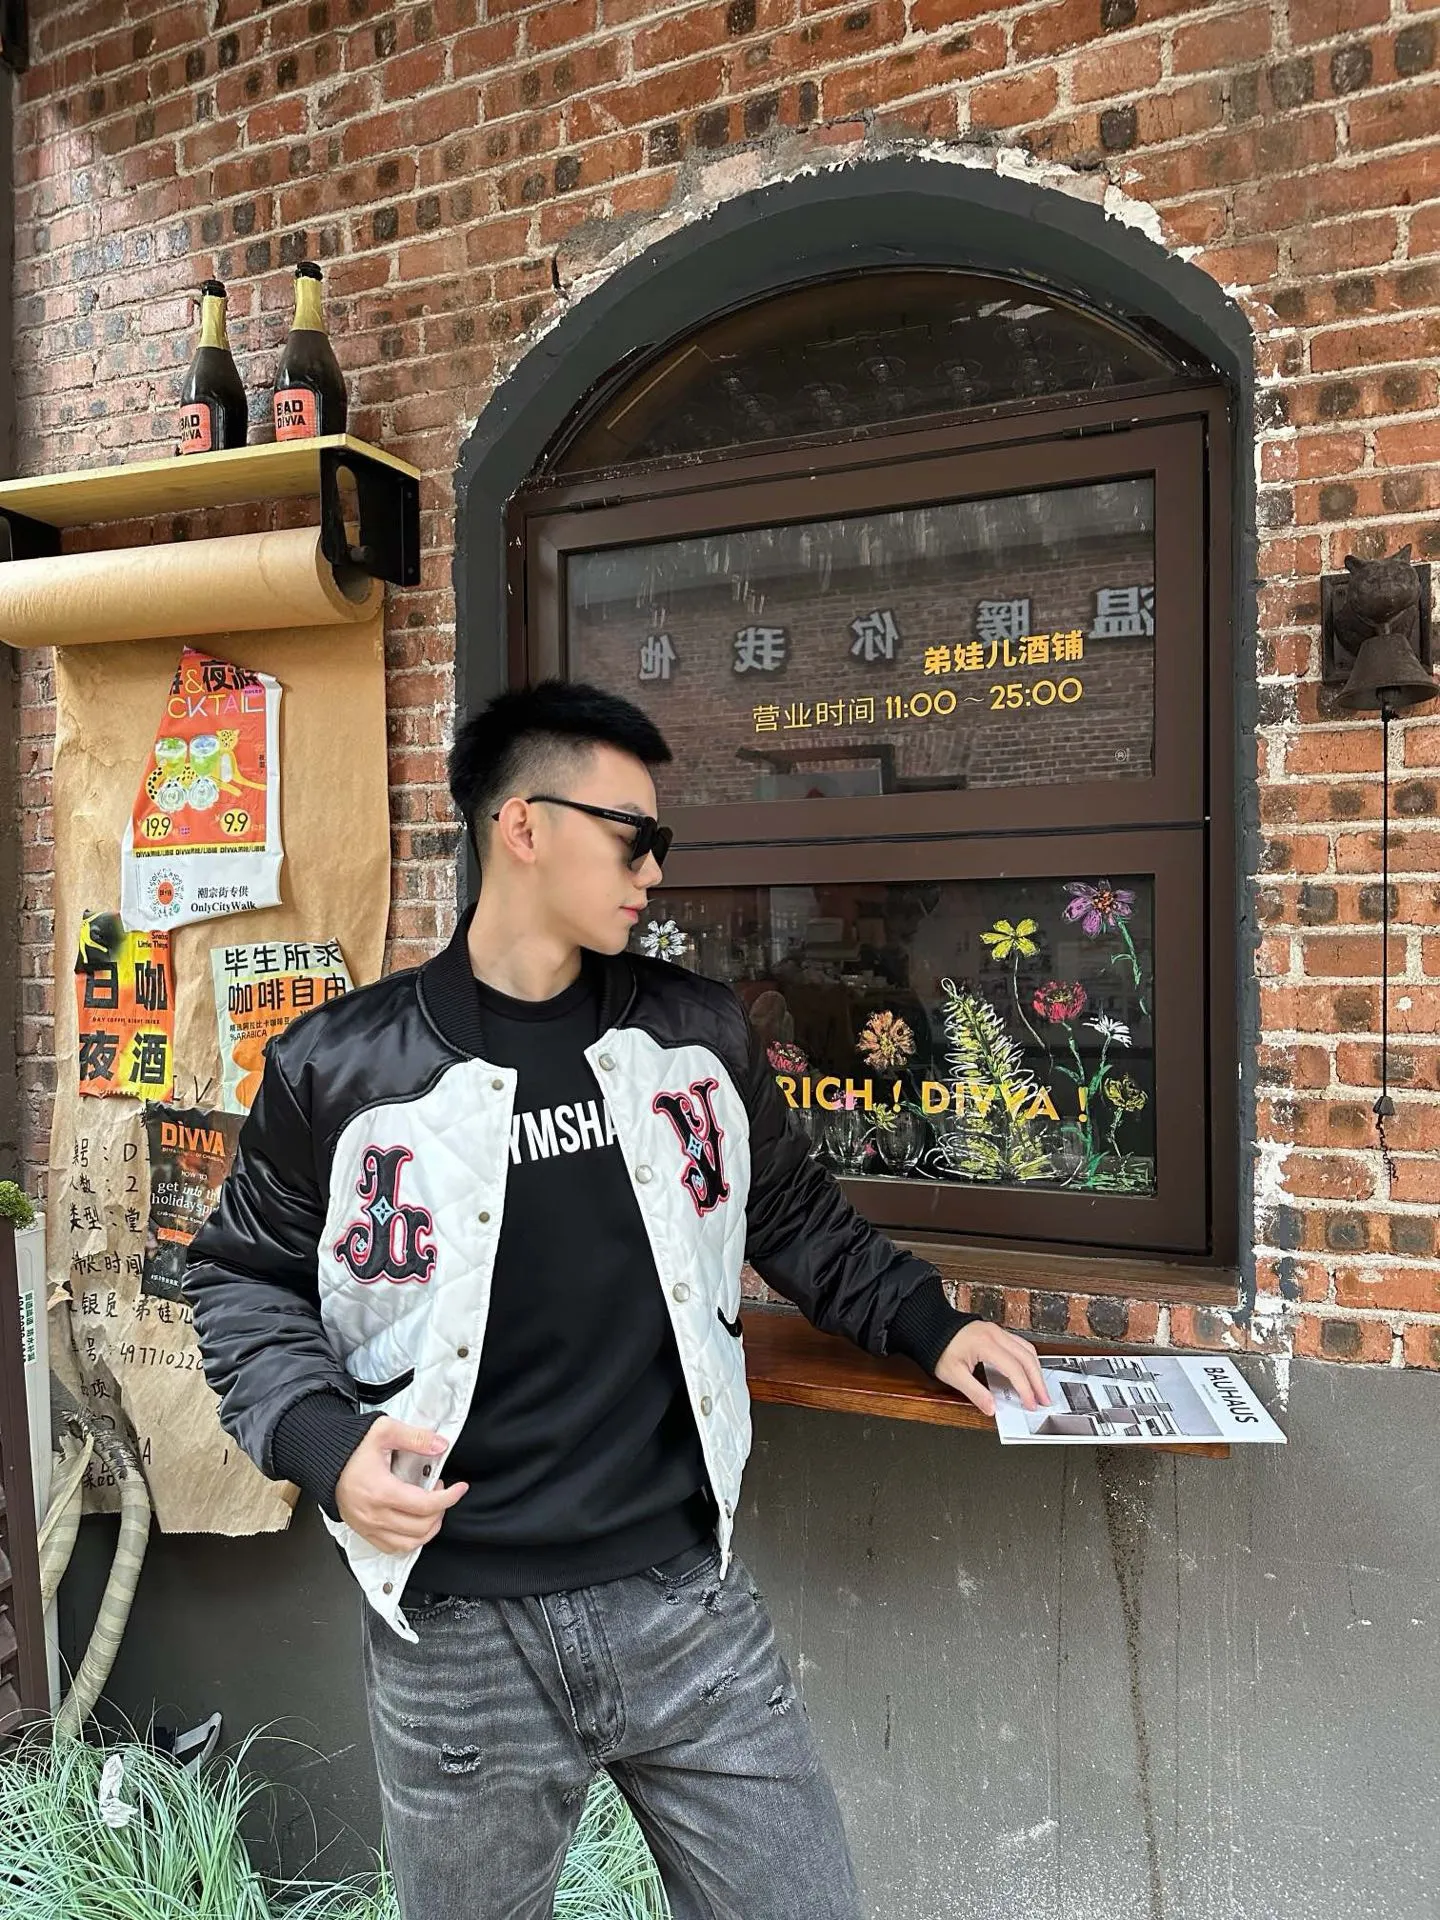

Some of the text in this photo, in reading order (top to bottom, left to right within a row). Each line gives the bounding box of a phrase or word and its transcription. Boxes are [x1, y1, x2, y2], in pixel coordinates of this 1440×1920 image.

[277, 400, 304, 416] BAD
[923, 630, 1084, 676] 弟娃儿酒铺
[752, 697, 875, 733] 营业时间
[885, 689, 957, 720] 11:00
[989, 677, 1083, 711] 25:00
[224, 813, 249, 833] 9.9
[197, 886, 249, 899] 潮宗街专供
[225, 943, 344, 977] 毕生所求
[228, 973, 347, 1015] 咖啡自由
[79, 1030, 168, 1085] 夜酒
[775, 1075, 873, 1111] RICH
[921, 1080, 1061, 1122] DIVVA
[157, 1181, 180, 1193] get
[1203, 1367, 1260, 1423] BAUHAUS
